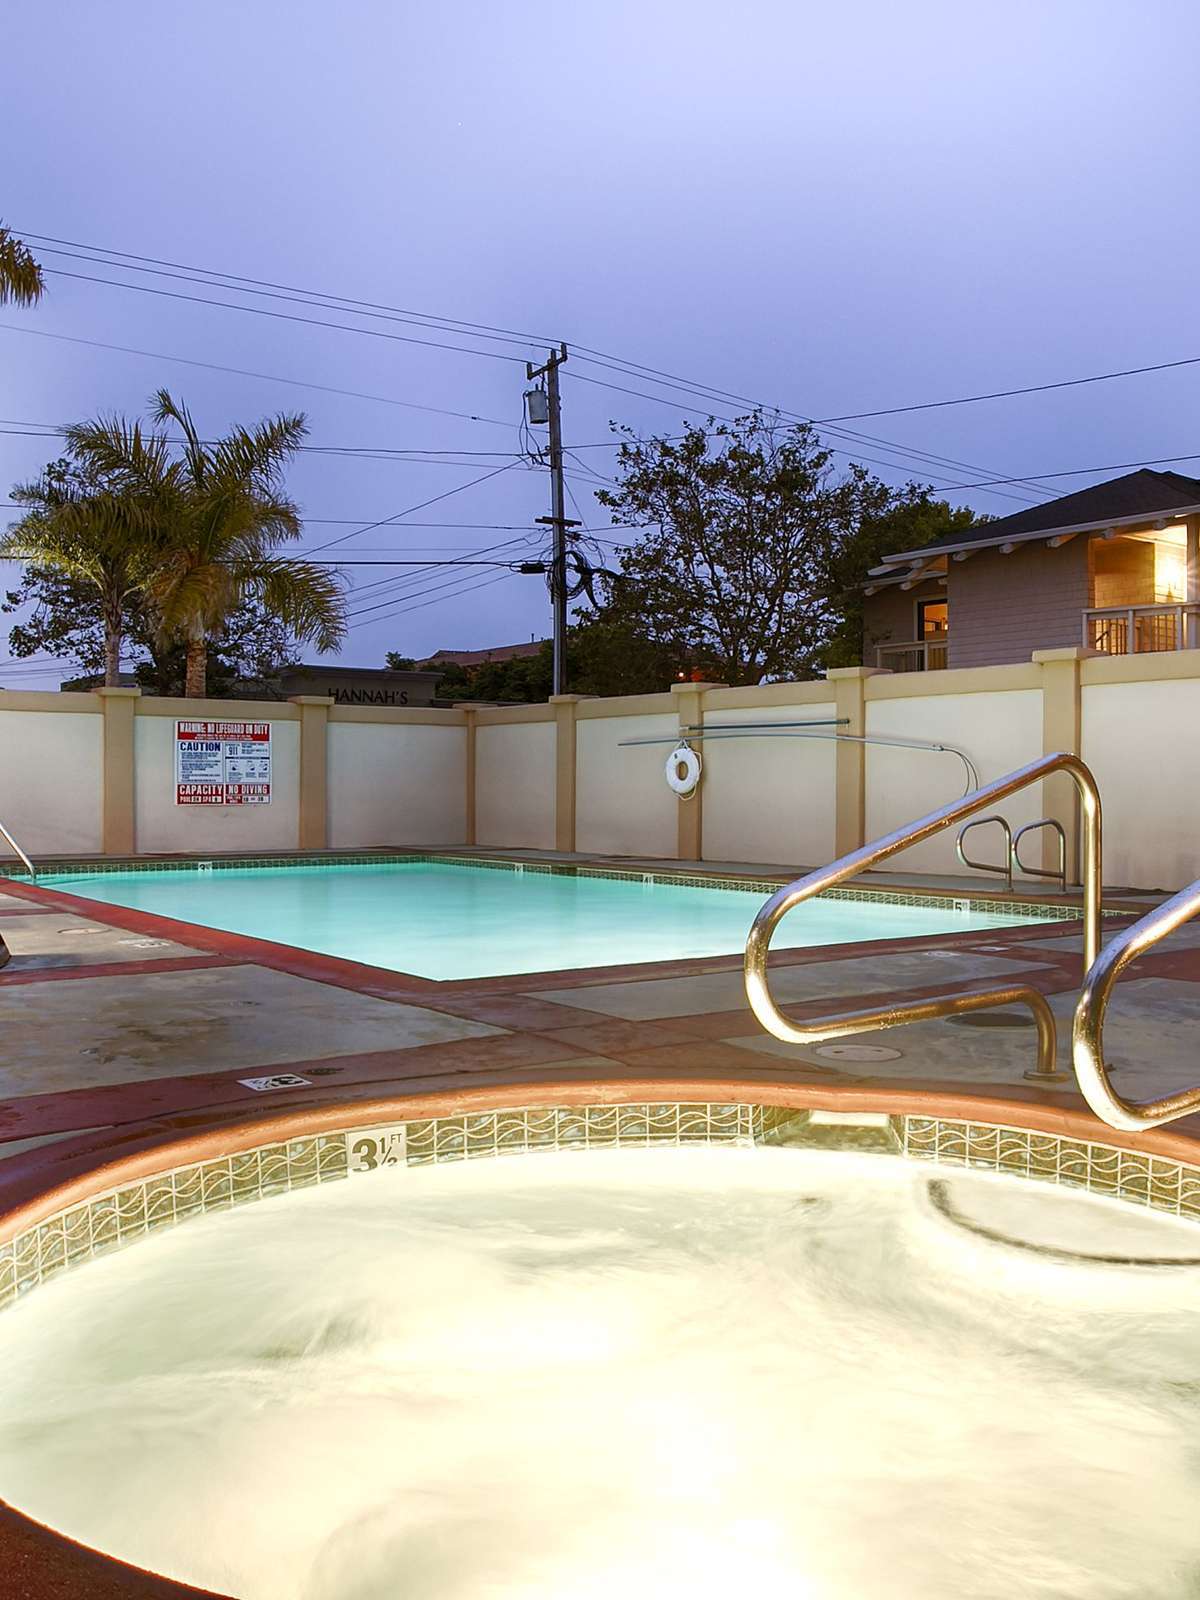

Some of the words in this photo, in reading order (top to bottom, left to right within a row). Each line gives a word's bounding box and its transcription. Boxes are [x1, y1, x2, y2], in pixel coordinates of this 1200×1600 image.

[328, 687, 409, 705] HANNAH'S
[207, 723, 215, 734] NO
[216, 723, 245, 734] LIFEGUARD
[245, 724, 254, 734] ON
[254, 724, 268, 735] DUTY
[180, 742, 221, 752] CAUTION
[179, 785, 223, 795] CAPACITY
[228, 785, 239, 794] NO
[241, 785, 268, 794] DIVING
[390, 1133, 402, 1144] FT
